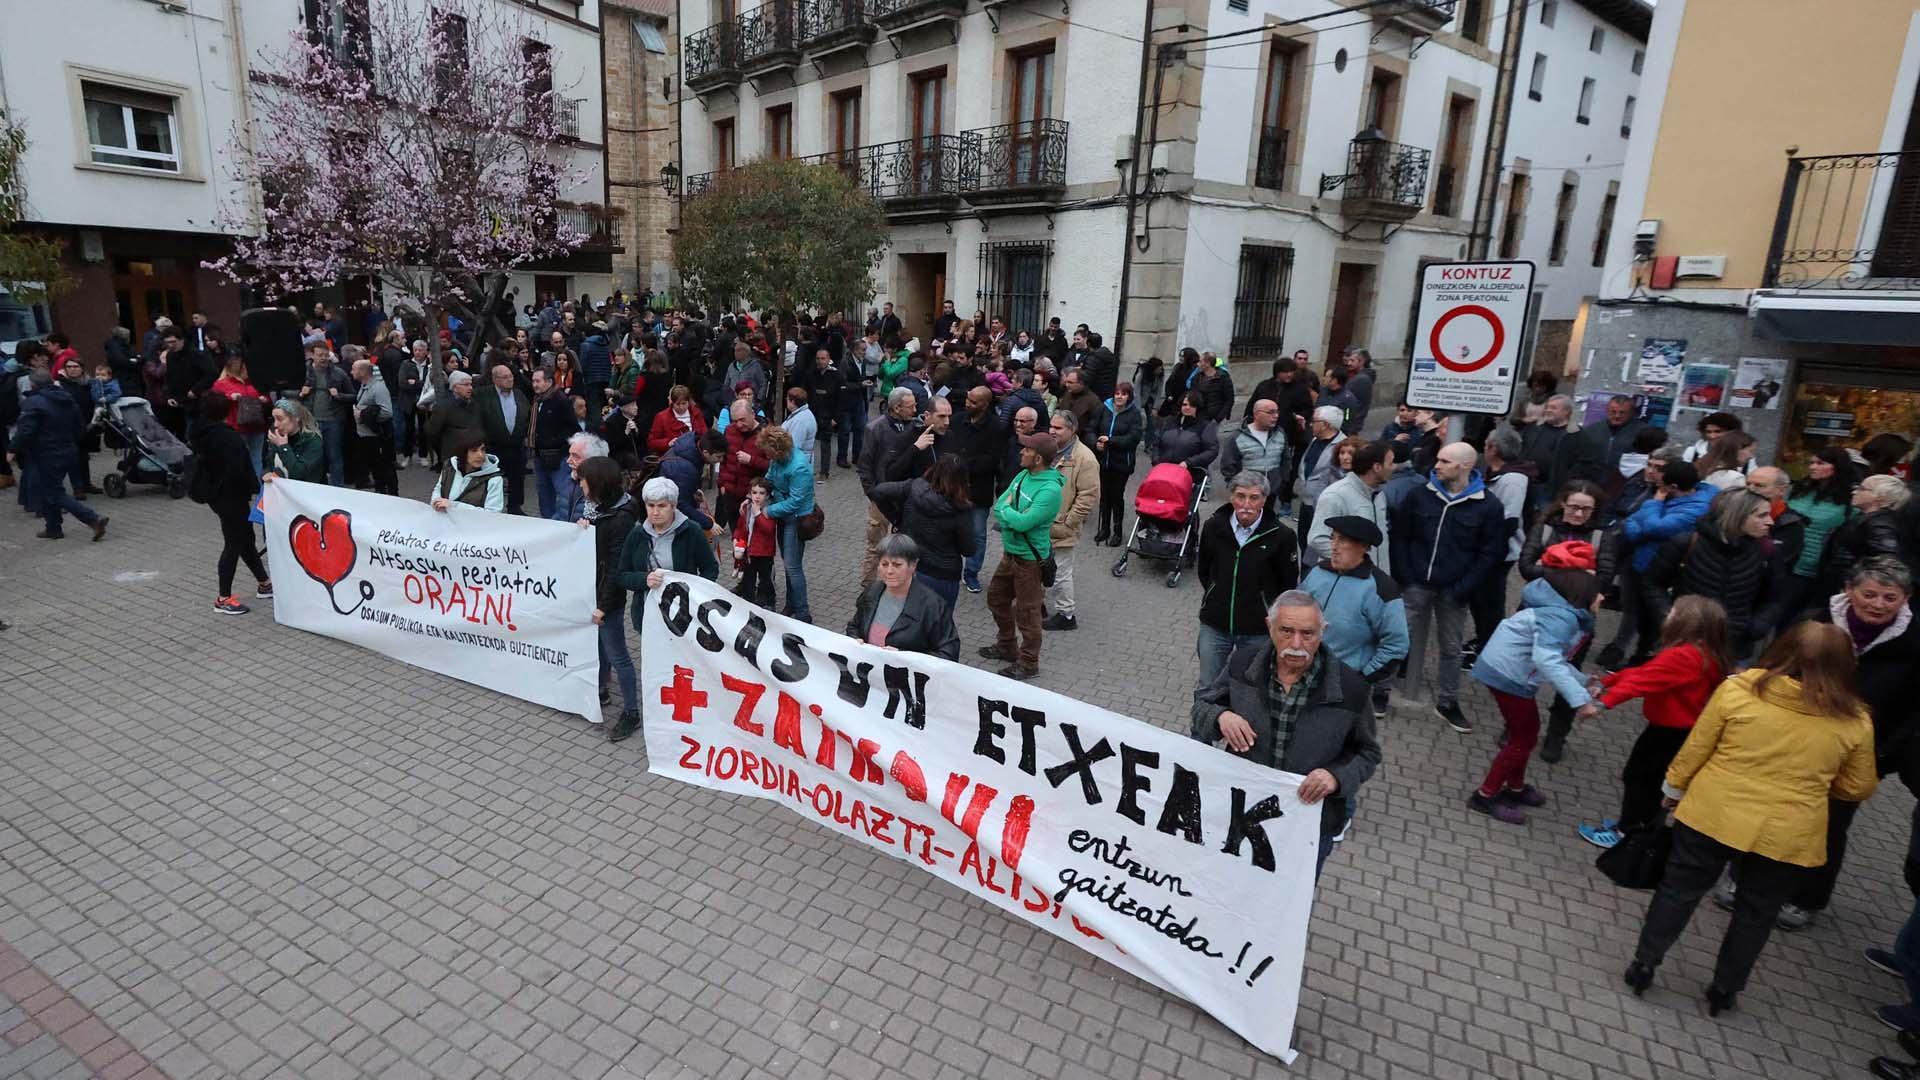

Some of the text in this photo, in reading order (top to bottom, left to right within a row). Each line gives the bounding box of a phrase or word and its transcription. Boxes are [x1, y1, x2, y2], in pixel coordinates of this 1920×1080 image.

[1441, 267, 1512, 280] KONTUZ
[1478, 282, 1526, 290] ALDERDIA
[1436, 294, 1510, 302] ZONA PEATONAL
[369, 546, 452, 581] Altsasun
[433, 541, 447, 554] en
[502, 546, 529, 570] YA!
[404, 574, 517, 631] ORAIN!
[360, 606, 569, 668] OSASUN PUBLIKOA ETA KALITATEZKOA GUZTIENTZAT
[973, 695, 1285, 873] ETXEAK
[1067, 829, 1193, 897] entzun
